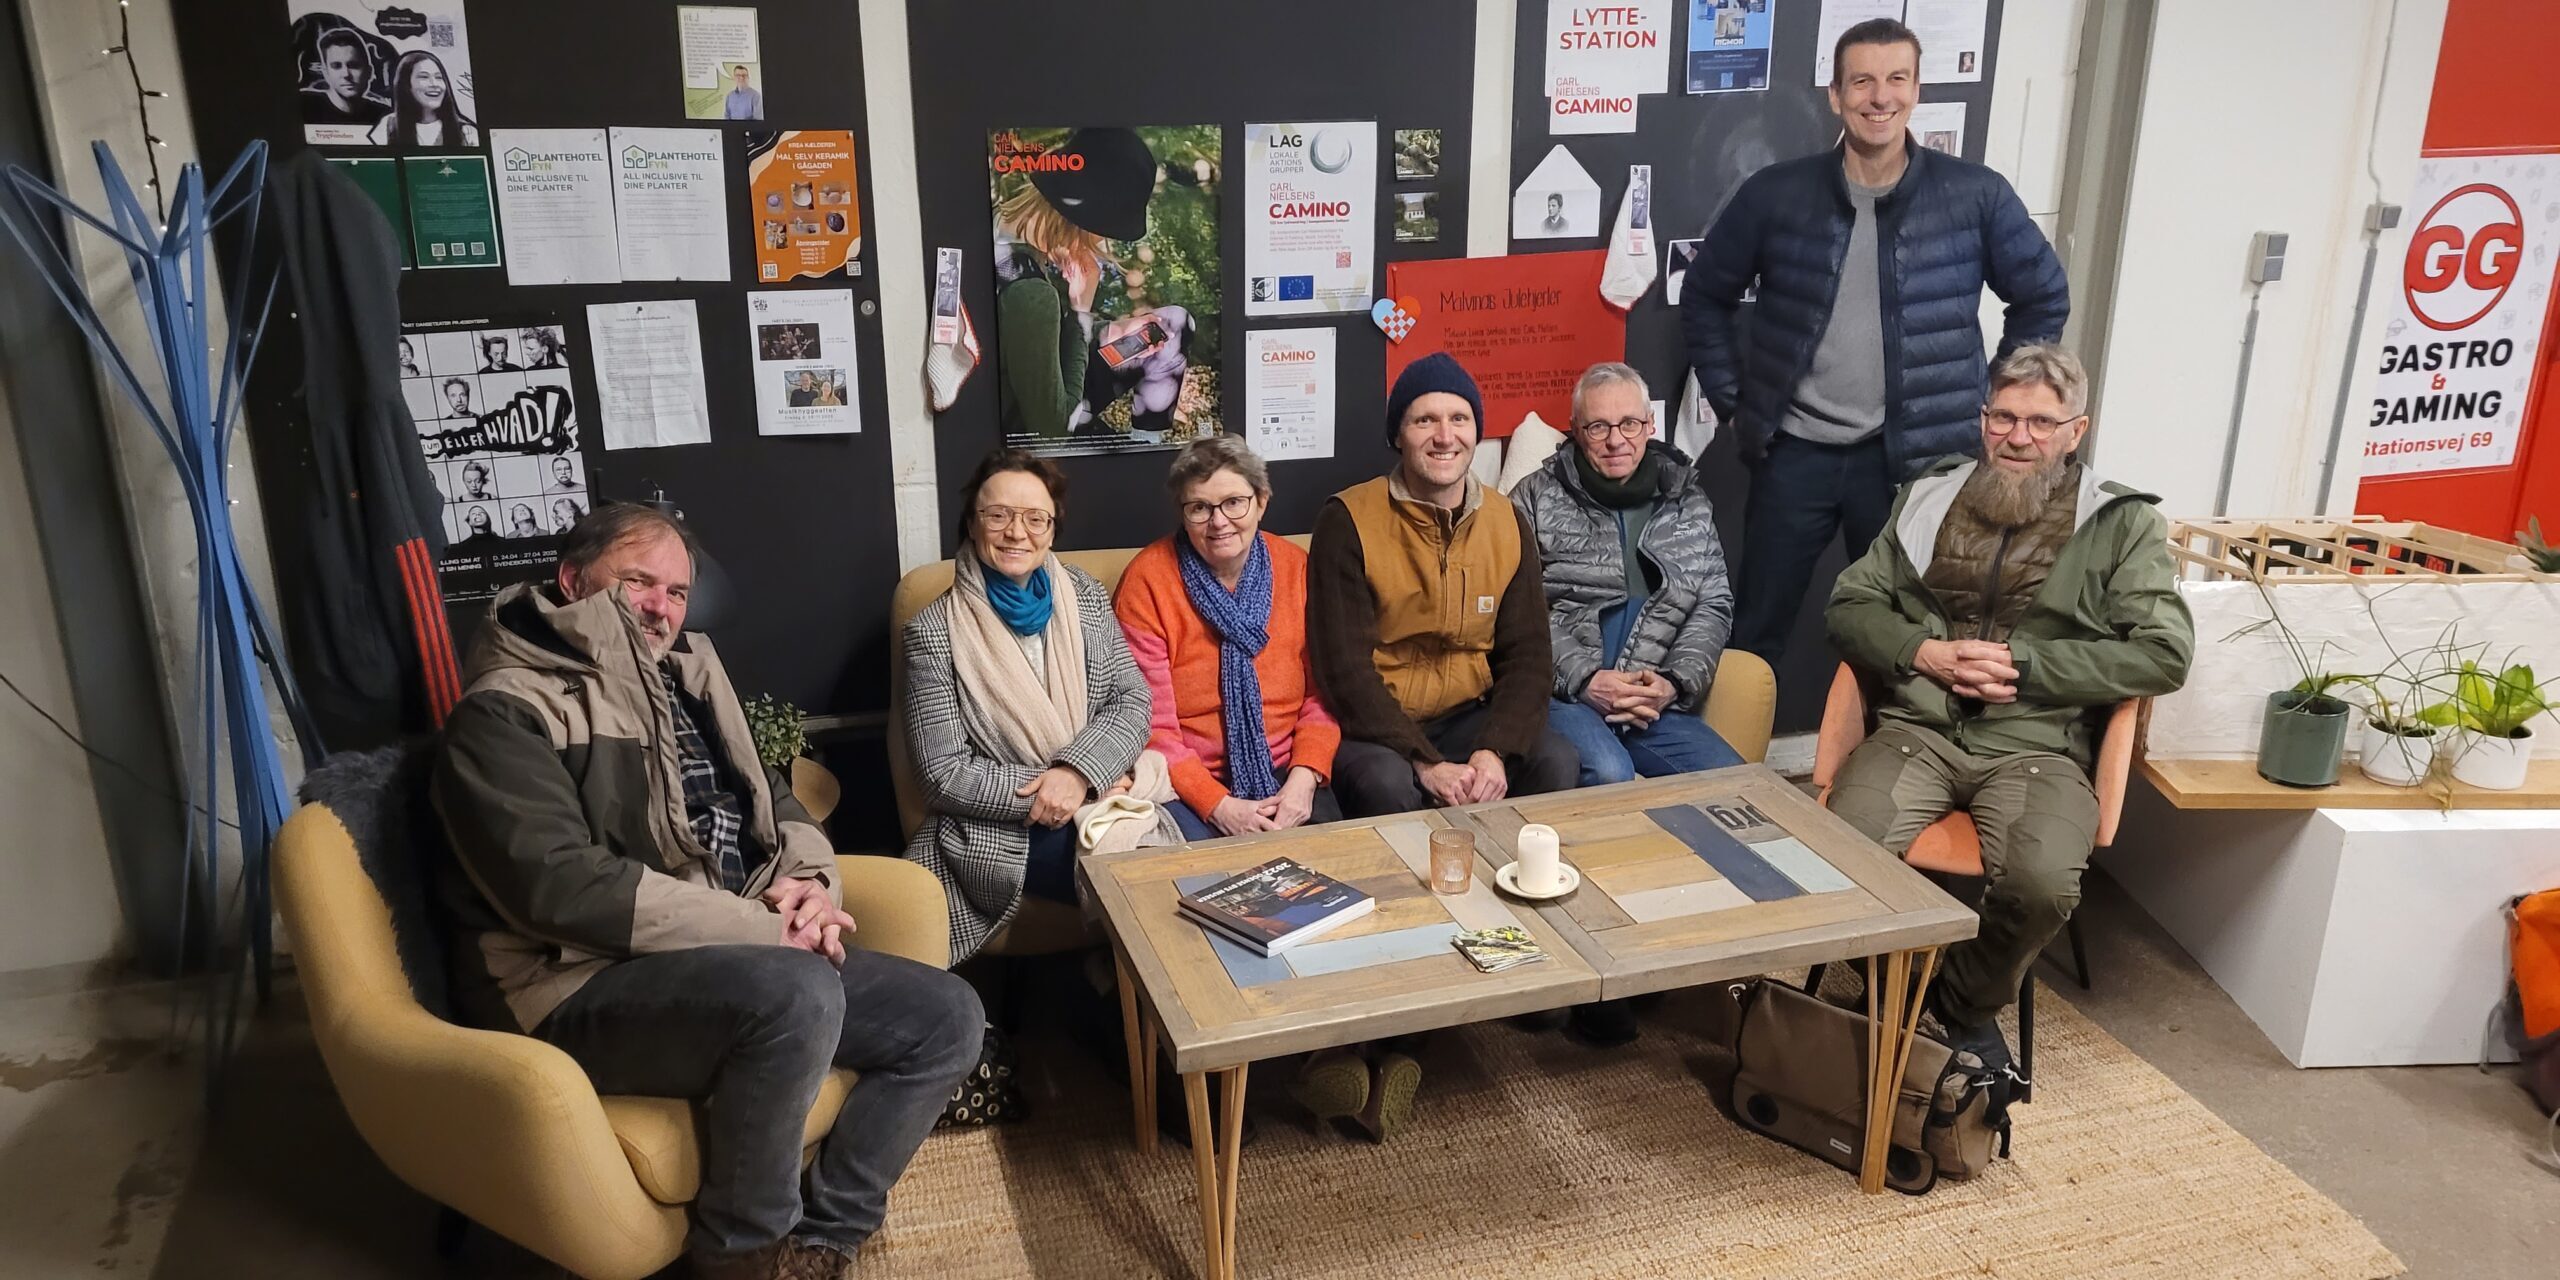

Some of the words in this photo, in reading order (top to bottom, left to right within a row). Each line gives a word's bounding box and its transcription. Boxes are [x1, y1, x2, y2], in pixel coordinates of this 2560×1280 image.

[1572, 8, 1647, 26] LYTTE-
[1560, 30, 1656, 50] STATION
[1556, 77, 1580, 86] CARL
[1555, 87, 1600, 96] NIELSENS
[1555, 97, 1633, 115] CAMINO
[994, 133, 1021, 143] CARL
[1270, 134, 1303, 148] LAG
[994, 143, 1045, 153] NIELSENS
[530, 152, 604, 162] PLANTEHOTEL
[647, 152, 718, 161] PLANTEHOTEL
[776, 153, 793, 161] MAL
[815, 152, 850, 160] KERAMIK
[1269, 151, 1299, 159] LOKALE
[532, 163, 552, 171] FYN
[648, 161, 668, 169] FYN
[994, 153, 1085, 172] CAMINO
[1269, 159, 1303, 167] AKTIONS
[1269, 166, 1304, 174] GRUPPER
[506, 175, 522, 183] ALL
[525, 174, 573, 182] INCLUSIVE
[576, 174, 589, 182] TIL
[691, 173, 703, 181] TIL
[531, 184, 574, 192] PLANTER
[624, 182, 645, 190] DINE
[647, 182, 688, 190] PLANTER
[1269, 182, 1294, 192] CARL
[1269, 191, 1315, 201] NIELSENS
[1269, 201, 1351, 219] CAMINO
[2404, 223, 2524, 294] GG
[1261, 350, 1316, 362] CAMINO
[2379, 338, 2513, 375] GASTRO
[2431, 373, 2447, 390] &
[2370, 391, 2502, 427] GAMING
[445, 432, 486, 448] ELLER
[484, 391, 561, 447] HVAD!
[2470, 431, 2493, 447] 69
[494, 559, 533, 568] SVENDBORG
[1262, 862, 1292, 876] 2022
